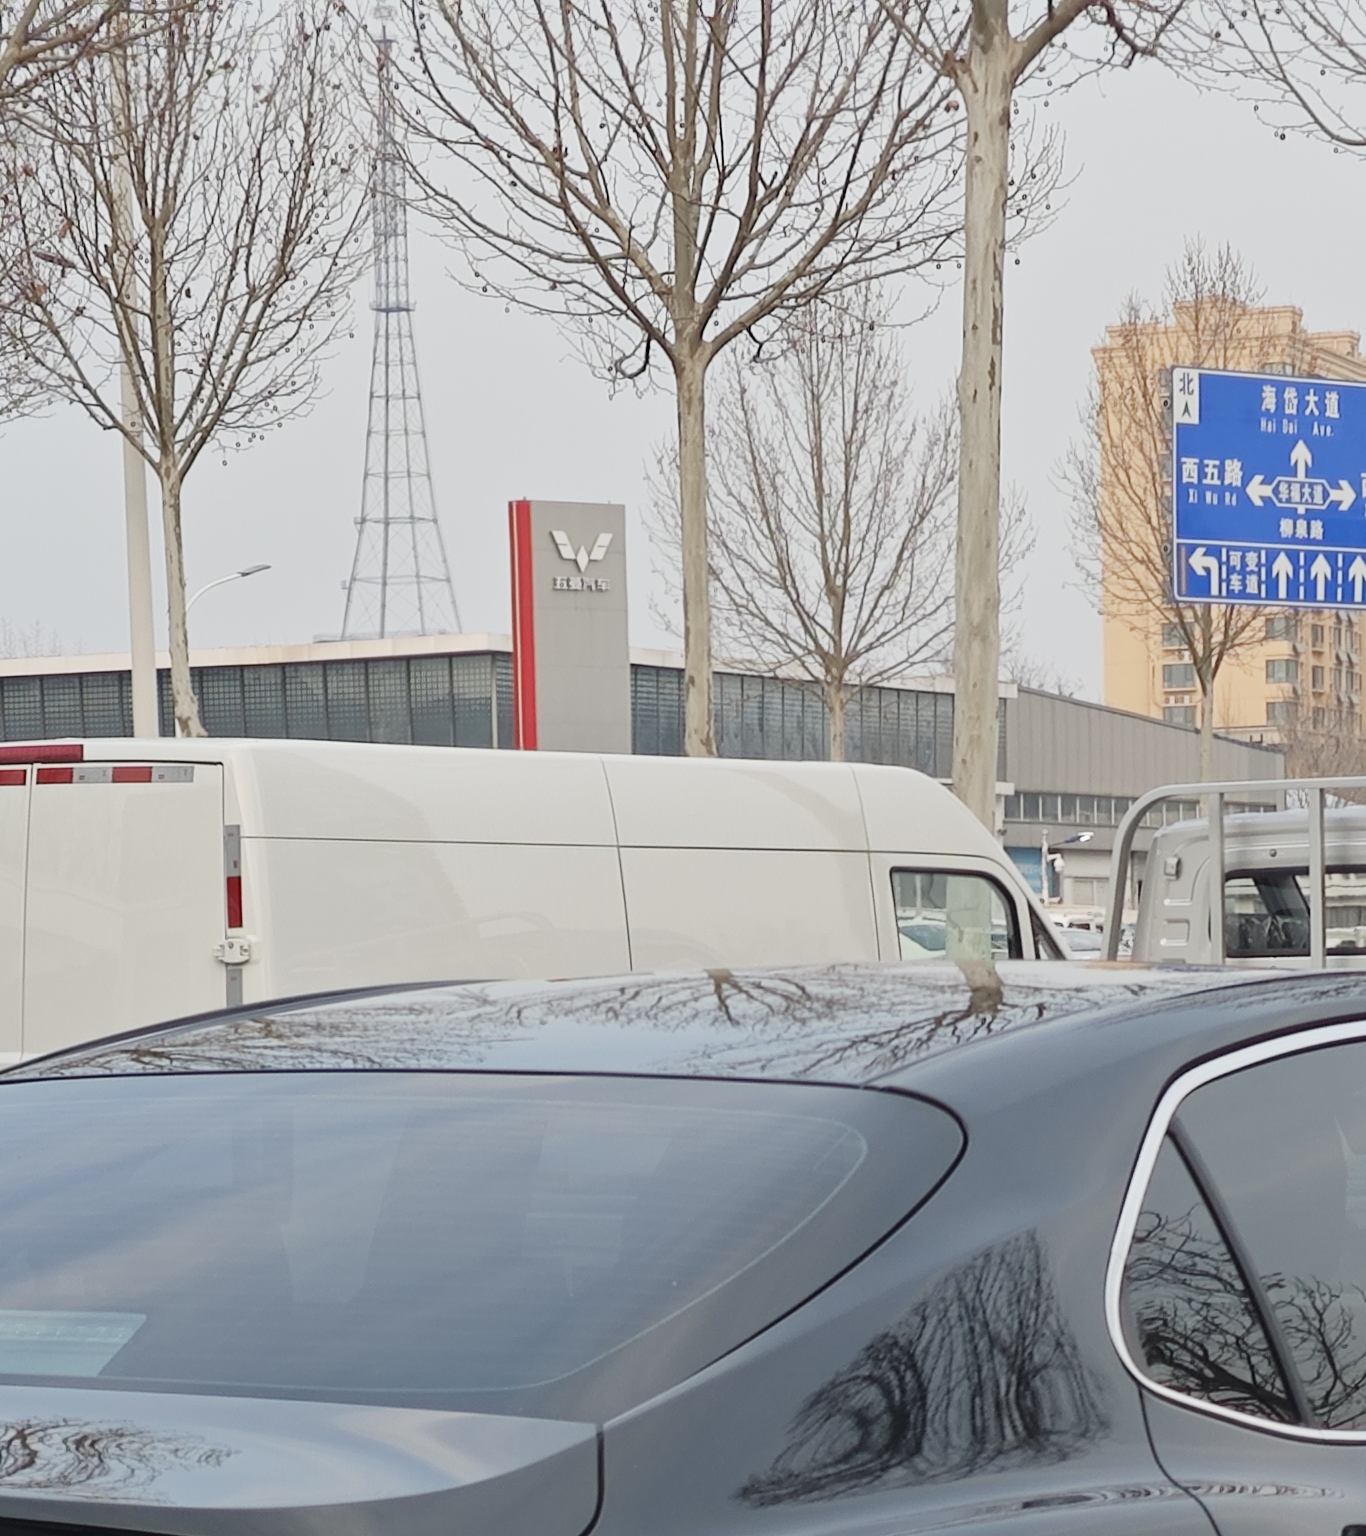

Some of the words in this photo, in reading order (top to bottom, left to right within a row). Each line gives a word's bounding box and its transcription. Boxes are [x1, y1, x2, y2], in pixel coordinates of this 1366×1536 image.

[1179, 373, 1194, 395] 北
[1261, 384, 1340, 418] 海岱大道
[1282, 418, 1297, 435] Dai
[1312, 421, 1334, 437] Ave.
[1181, 457, 1243, 487] 西五路
[1229, 551, 1259, 571] 可变
[1229, 573, 1259, 595] 车道
